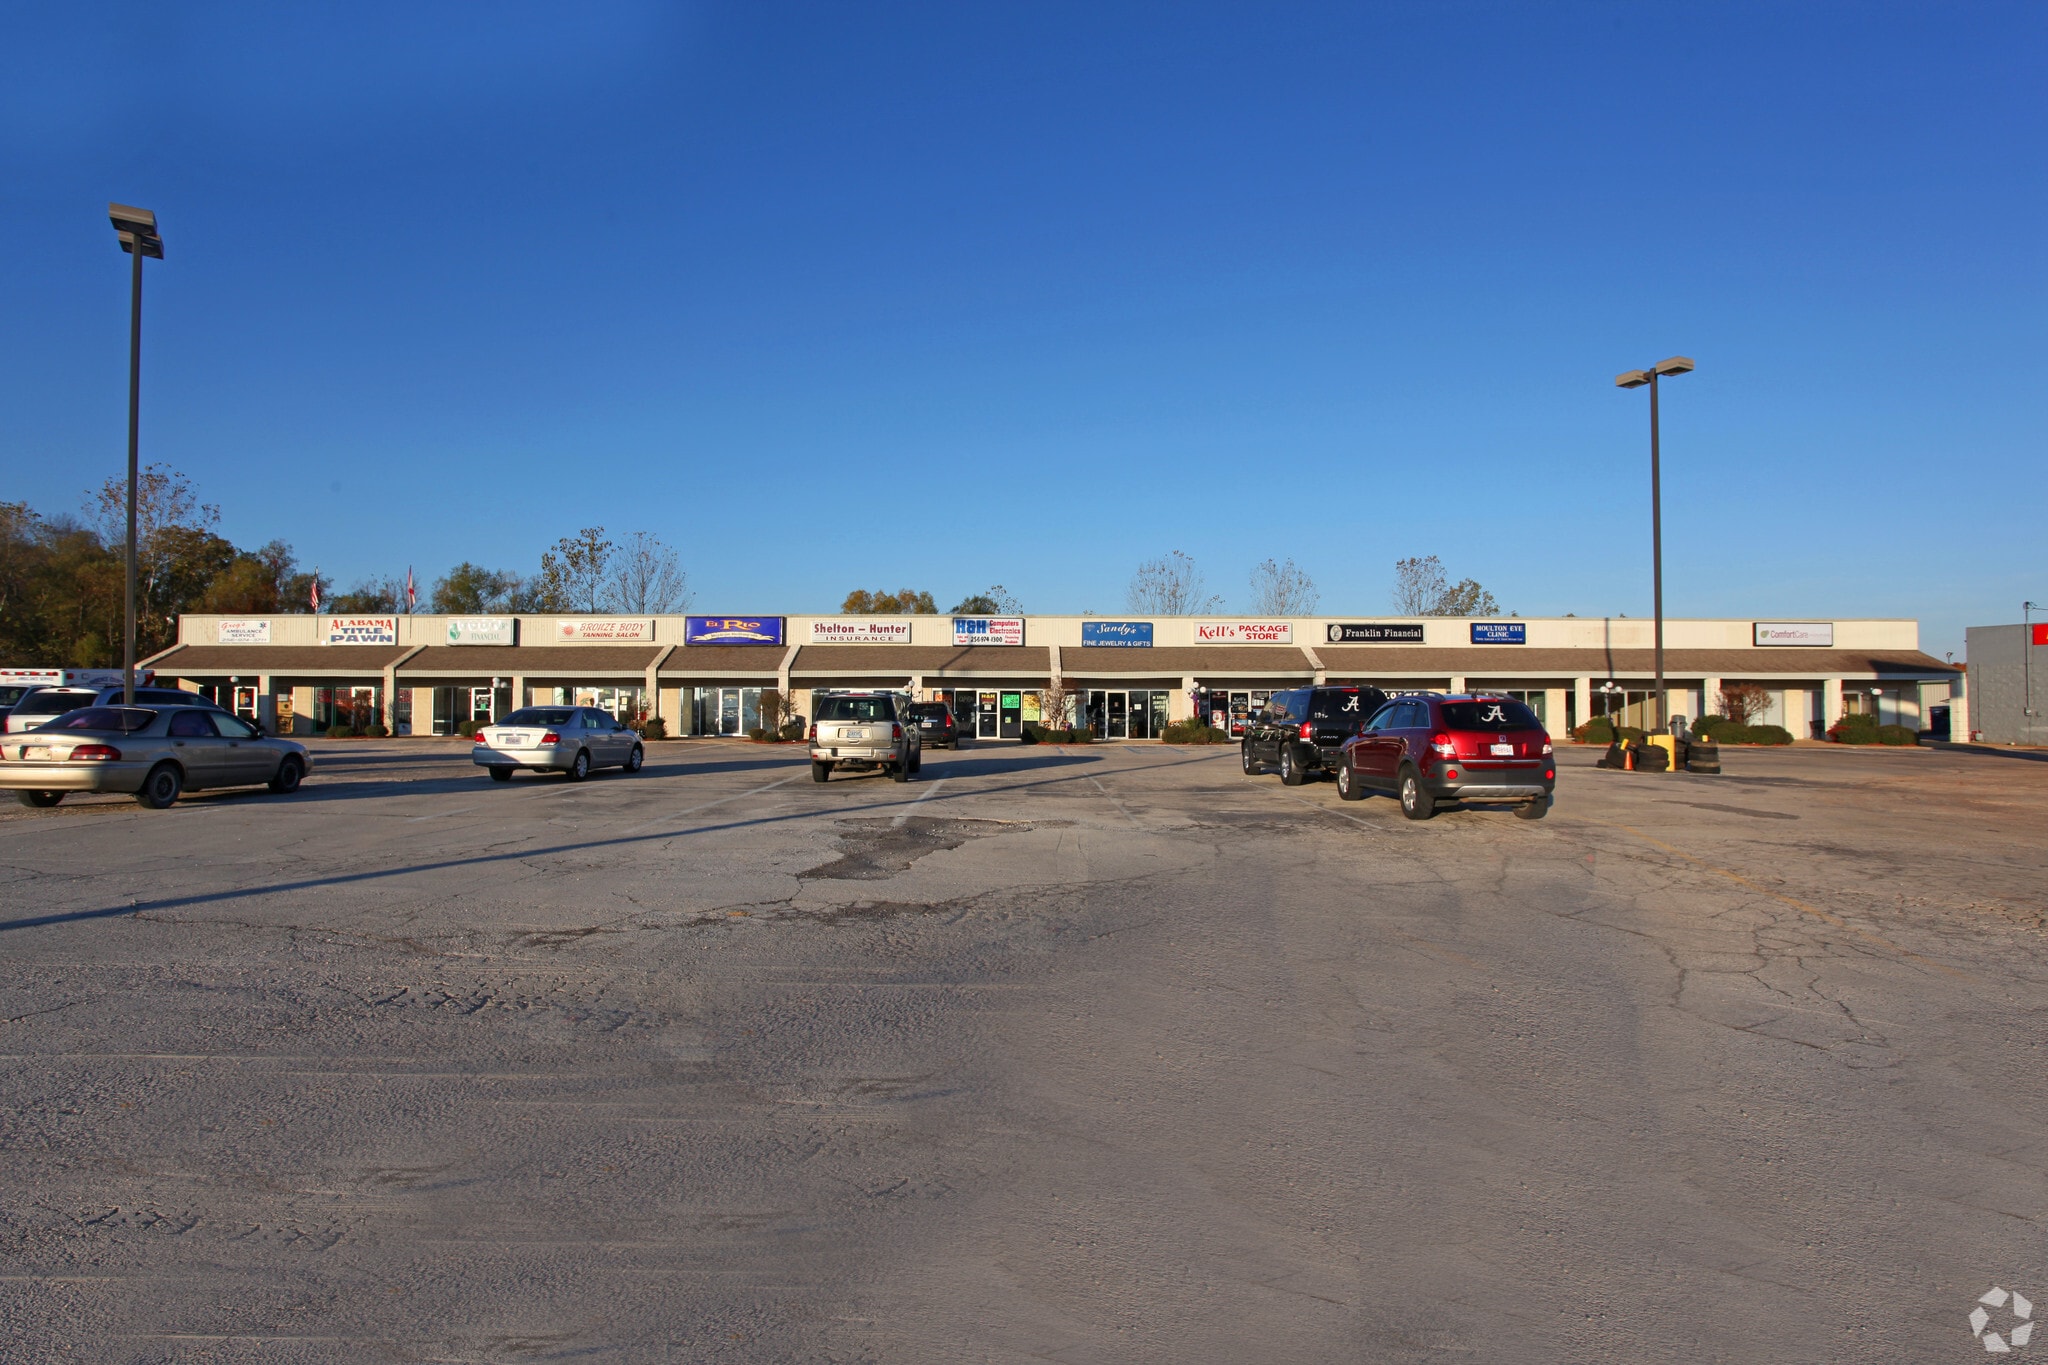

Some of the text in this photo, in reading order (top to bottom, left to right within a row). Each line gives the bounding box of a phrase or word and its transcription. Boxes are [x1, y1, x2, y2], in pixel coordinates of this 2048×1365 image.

[331, 619, 393, 631] ALABAMA
[580, 623, 646, 631] BRONZE BODY
[814, 623, 855, 633] Shelton
[869, 623, 907, 633] Hunter
[955, 619, 987, 634] H&H
[1096, 623, 1137, 635] Sandy's
[1199, 625, 1235, 639] Kell's
[1245, 632, 1279, 640] STORE
[1345, 628, 1421, 637] Franklin Financial
[1770, 630, 1809, 638] ComfortCare
[1341, 695, 1360, 712] A
[1481, 704, 1507, 722] A
